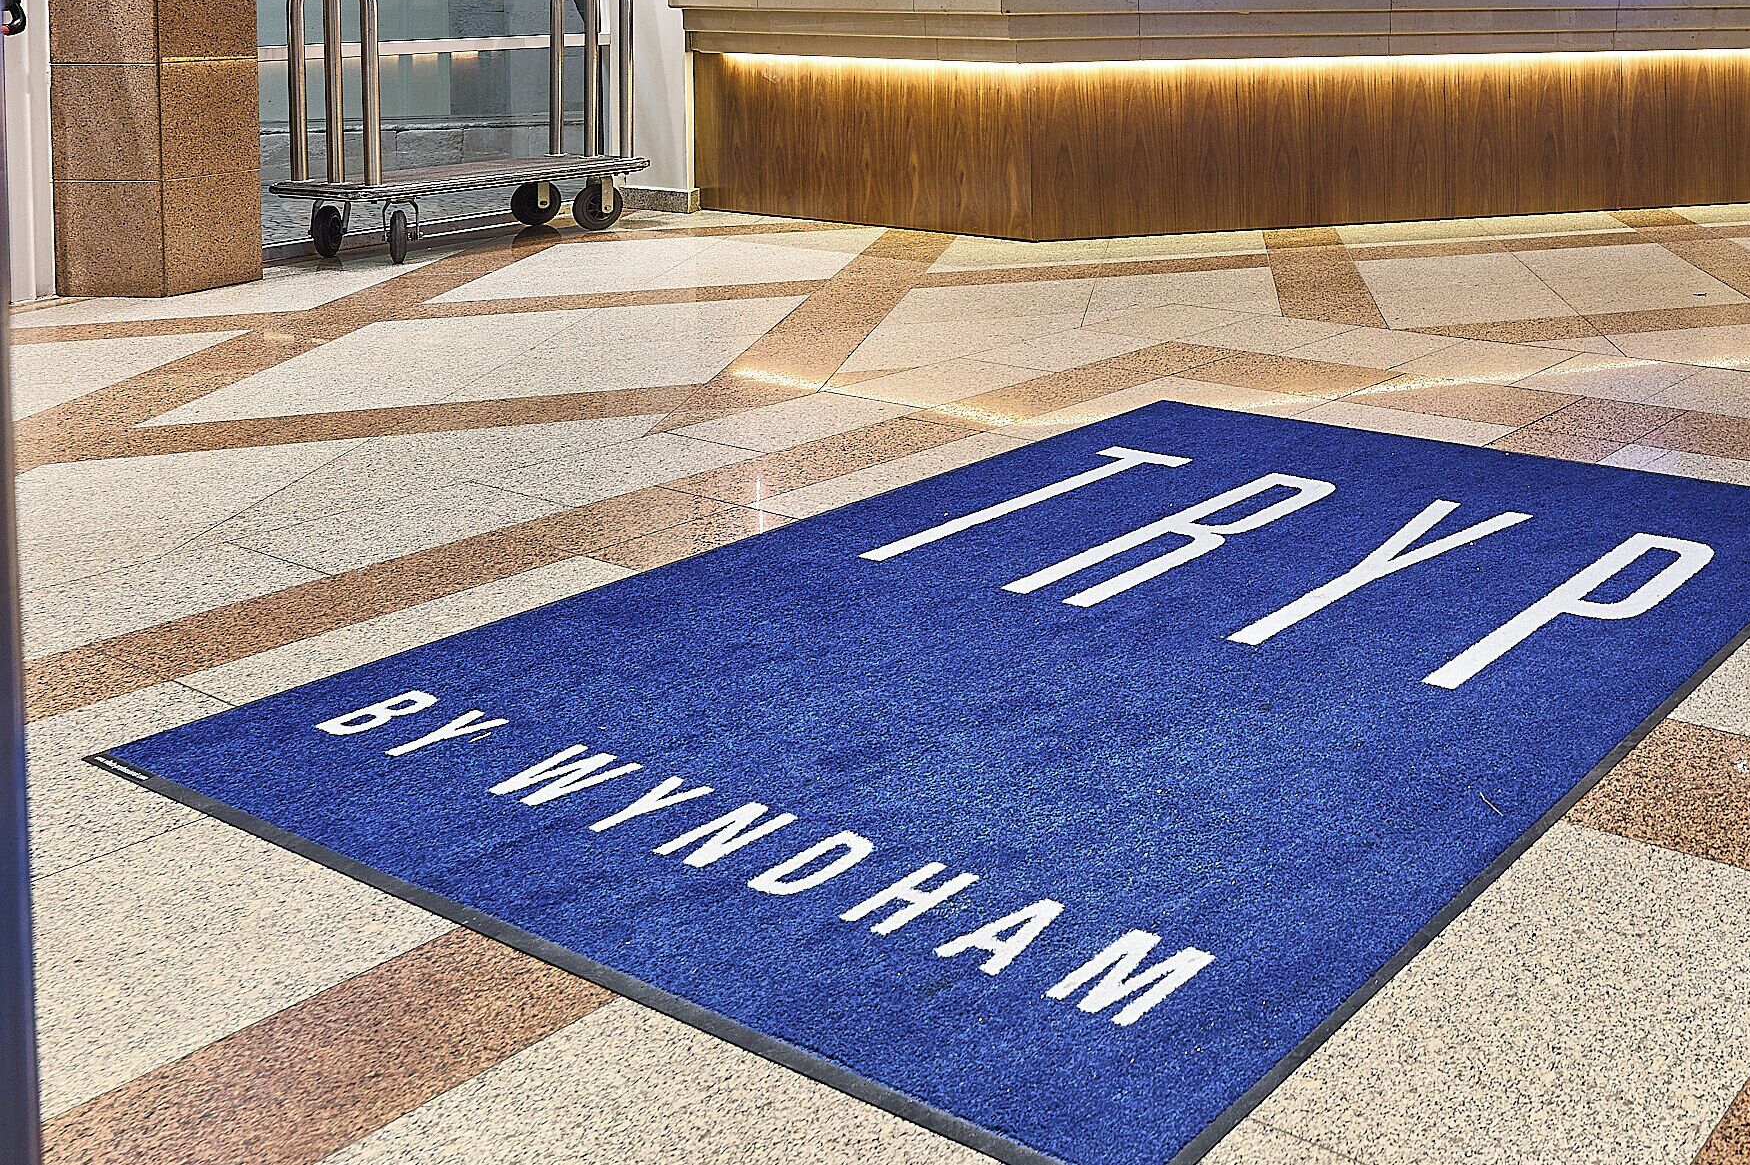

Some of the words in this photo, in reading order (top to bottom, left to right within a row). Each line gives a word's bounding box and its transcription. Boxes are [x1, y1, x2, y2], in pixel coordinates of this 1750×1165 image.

[860, 445, 1716, 690] TRYP
[315, 689, 509, 757] BY
[488, 743, 1216, 1027] WYNDHAM
